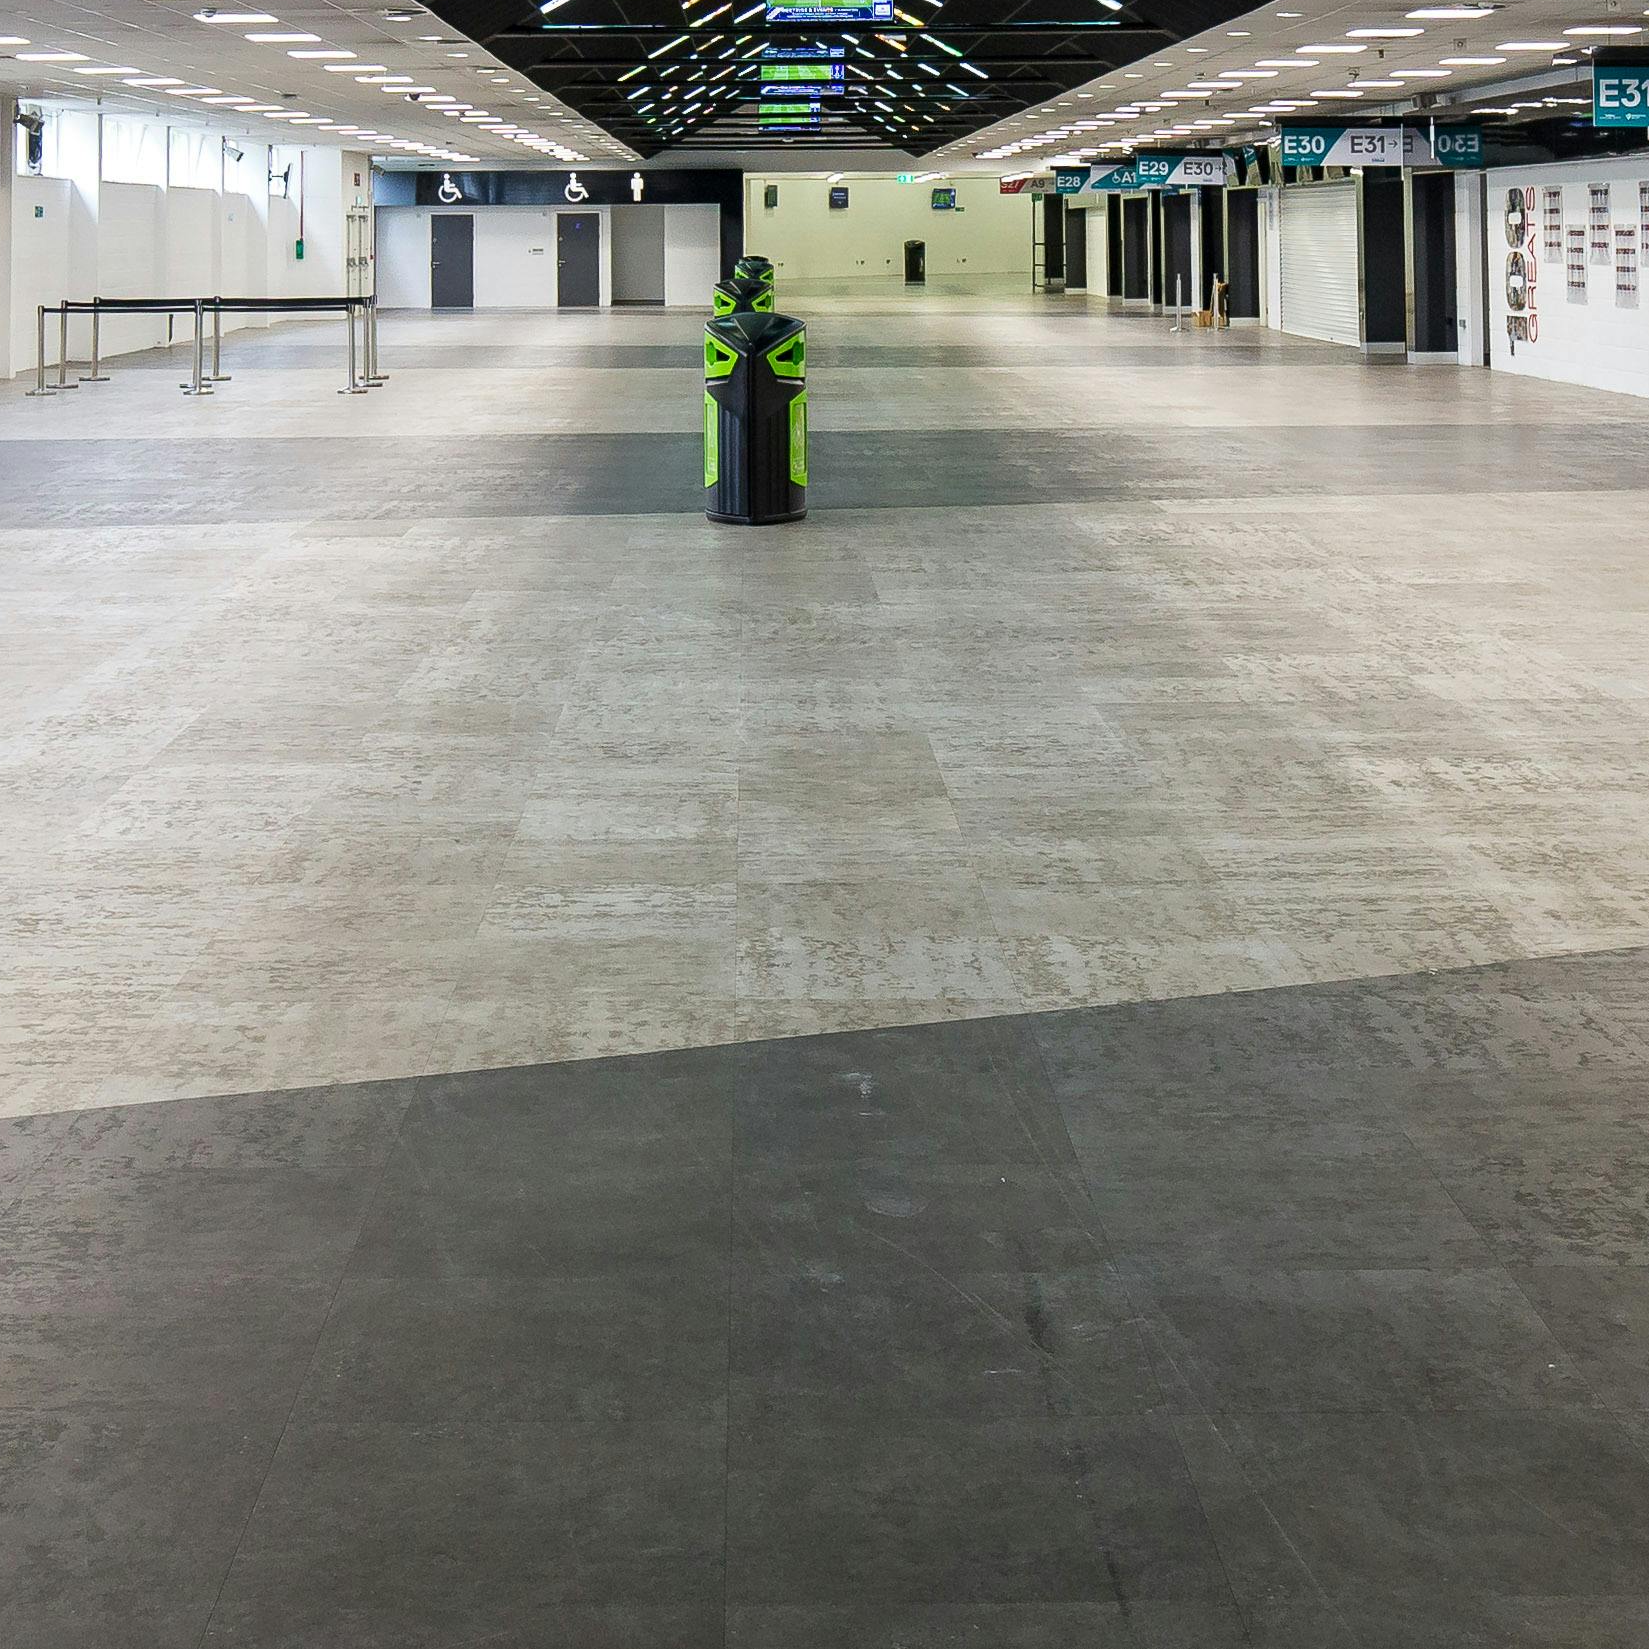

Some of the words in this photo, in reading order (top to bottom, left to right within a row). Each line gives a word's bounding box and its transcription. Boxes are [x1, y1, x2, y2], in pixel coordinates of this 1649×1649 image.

[1284, 136, 1325, 154] E30
[1350, 136, 1386, 153] E31
[1139, 162, 1168, 175] E29
[1184, 162, 1213, 175] E30
[1057, 177, 1080, 187] E28
[1122, 172, 1137, 183] A1
[1031, 180, 1044, 188] A9
[1526, 186, 1539, 343] GREATS
